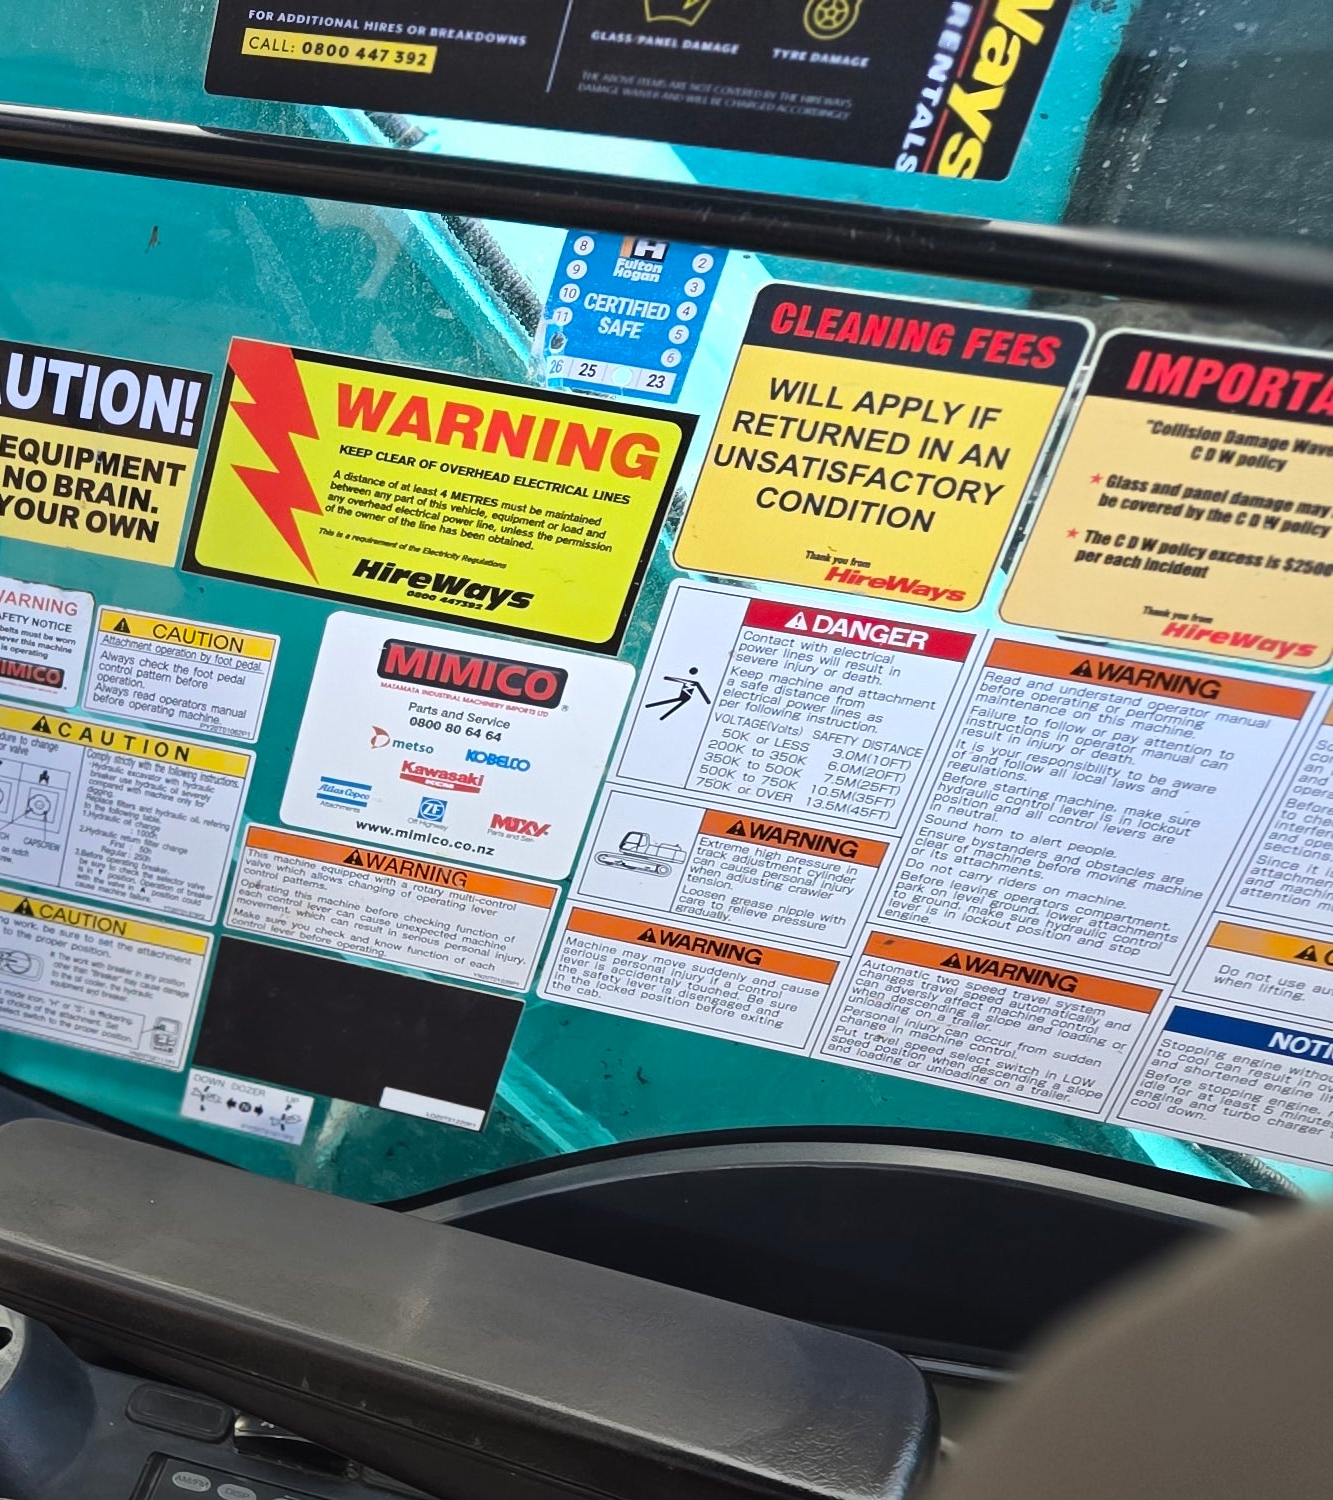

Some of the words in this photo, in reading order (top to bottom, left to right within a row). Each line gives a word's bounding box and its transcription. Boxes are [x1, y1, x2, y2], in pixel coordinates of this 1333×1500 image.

[249, 9, 274, 22] FOR
[278, 12, 359, 31] ADDITIONAL
[364, 20, 402, 35] HIRES
[407, 24, 427, 36] OR
[431, 27, 527, 47] BREAKDOWNS
[249, 36, 295, 53] CALL:
[302, 42, 349, 59] 0800
[355, 47, 390, 63] 447
[394, 51, 428, 67] 392
[682, 39, 740, 55] DAMAGE
[772, 48, 807, 62] TYRE
[810, 53, 870, 68] DAMAGE
[895, 1, 973, 173] RENTALS
[579, 240, 588, 251] 8
[572, 264, 581, 275] 9
[613, 267, 661, 282] Hogan
[616, 258, 663, 273] Fulton
[697, 258, 708, 269] 2
[563, 287, 577, 299] 10
[690, 282, 699, 293] 3
[556, 311, 569, 322] 11
[584, 293, 671, 321] CERTIFIED
[682, 306, 691, 317] 4
[598, 317, 645, 339] SAFE
[675, 329, 684, 340] 5
[770, 302, 955, 357] CLEANING
[961, 326, 1062, 370] FEES
[666, 352, 675, 363] 6
[550, 359, 564, 374] 26
[579, 363, 597, 378] 25
[646, 374, 666, 389] 23
[769, 377, 845, 410] WILL
[852, 390, 965, 425] APPLY
[968, 406, 1003, 430] IF
[336, 382, 662, 482] WARNING
[733, 410, 911, 456] RETURNED
[918, 437, 954, 462] IN
[958, 443, 1011, 470] AN
[1224, 430, 1289, 452] Damage
[339, 444, 373, 458] KEEP
[375, 451, 417, 467] CLEAR
[419, 459, 437, 471] OF
[439, 462, 511, 484] OVERHEAD
[513, 476, 589, 498] ELECTRICAL
[592, 489, 631, 505] LINES
[713, 443, 1005, 507] UNSATISFACTORY
[2, 466, 47, 493] NO
[53, 474, 159, 514] BRAIN.
[333, 470, 341, 479] A
[343, 472, 386, 488] distance
[388, 479, 399, 489] of
[401, 482, 411, 491] at
[413, 484, 438, 497] least
[440, 488, 448, 498] 4
[450, 490, 499, 508] METRES
[501, 501, 528, 514] must
[529, 505, 542, 516] be
[545, 508, 602, 526] maintained
[1106, 474, 1148, 493] Glass
[1151, 479, 1182, 497] and
[1183, 485, 1227, 505] panel
[1229, 490, 1292, 515] damage
[1296, 500, 1331, 519] may
[756, 486, 936, 533] CONDITION
[85, 511, 159, 544] OWN
[352, 559, 535, 610] HireWays
[406, 590, 437, 601] 0800
[823, 566, 967, 603] HireWays
[0, 624, 19, 635] belts
[21, 629, 42, 639] must
[43, 633, 53, 641] be
[56, 636, 76, 646] worn
[32, 618, 73, 633] NOTICE
[153, 623, 245, 653] CAUTION
[812, 614, 930, 650] DANGER
[1, 643, 8, 651] is
[10, 645, 48, 659] operating
[21, 638, 36, 647] this
[38, 643, 73, 654] machine
[102, 634, 152, 650] Attachment
[156, 644, 197, 661] operation
[200, 653, 211, 664] by
[215, 655, 233, 667] foot
[235, 659, 262, 671] pedal.
[743, 630, 795, 648] Contact
[801, 641, 828, 653] with
[834, 645, 895, 665] electrical
[1161, 622, 1318, 660] HireWays
[384, 644, 558, 701] MIMICO
[1095, 663, 1222, 701] WARNING
[408, 702, 438, 716] Parts
[441, 708, 464, 721] and
[467, 712, 511, 729] Service
[409, 717, 441, 730] 0800
[445, 723, 462, 735] 80
[465, 727, 482, 738] 64
[485, 731, 502, 742] 64
[58, 721, 191, 762] CAUTION
[392, 738, 434, 755] metso
[714, 711, 803, 737] VOLTAGE(Volts)
[812, 730, 859, 746] SAFETY
[862, 739, 924, 759] DISTANCE
[401, 760, 484, 787] Kawasaki
[465, 749, 531, 772] KOBELCO
[422, 801, 443, 816] ZF
[356, 820, 495, 856] www.mimico.co.nz
[747, 821, 860, 859] WARNING
[365, 852, 469, 888] WARNING
[39, 904, 128, 936] CAUTION
[659, 929, 764, 966] WARNING
[965, 955, 1080, 995] WARNING
[193, 1072, 226, 1088] DOWN
[231, 1081, 266, 1098] DOZER
